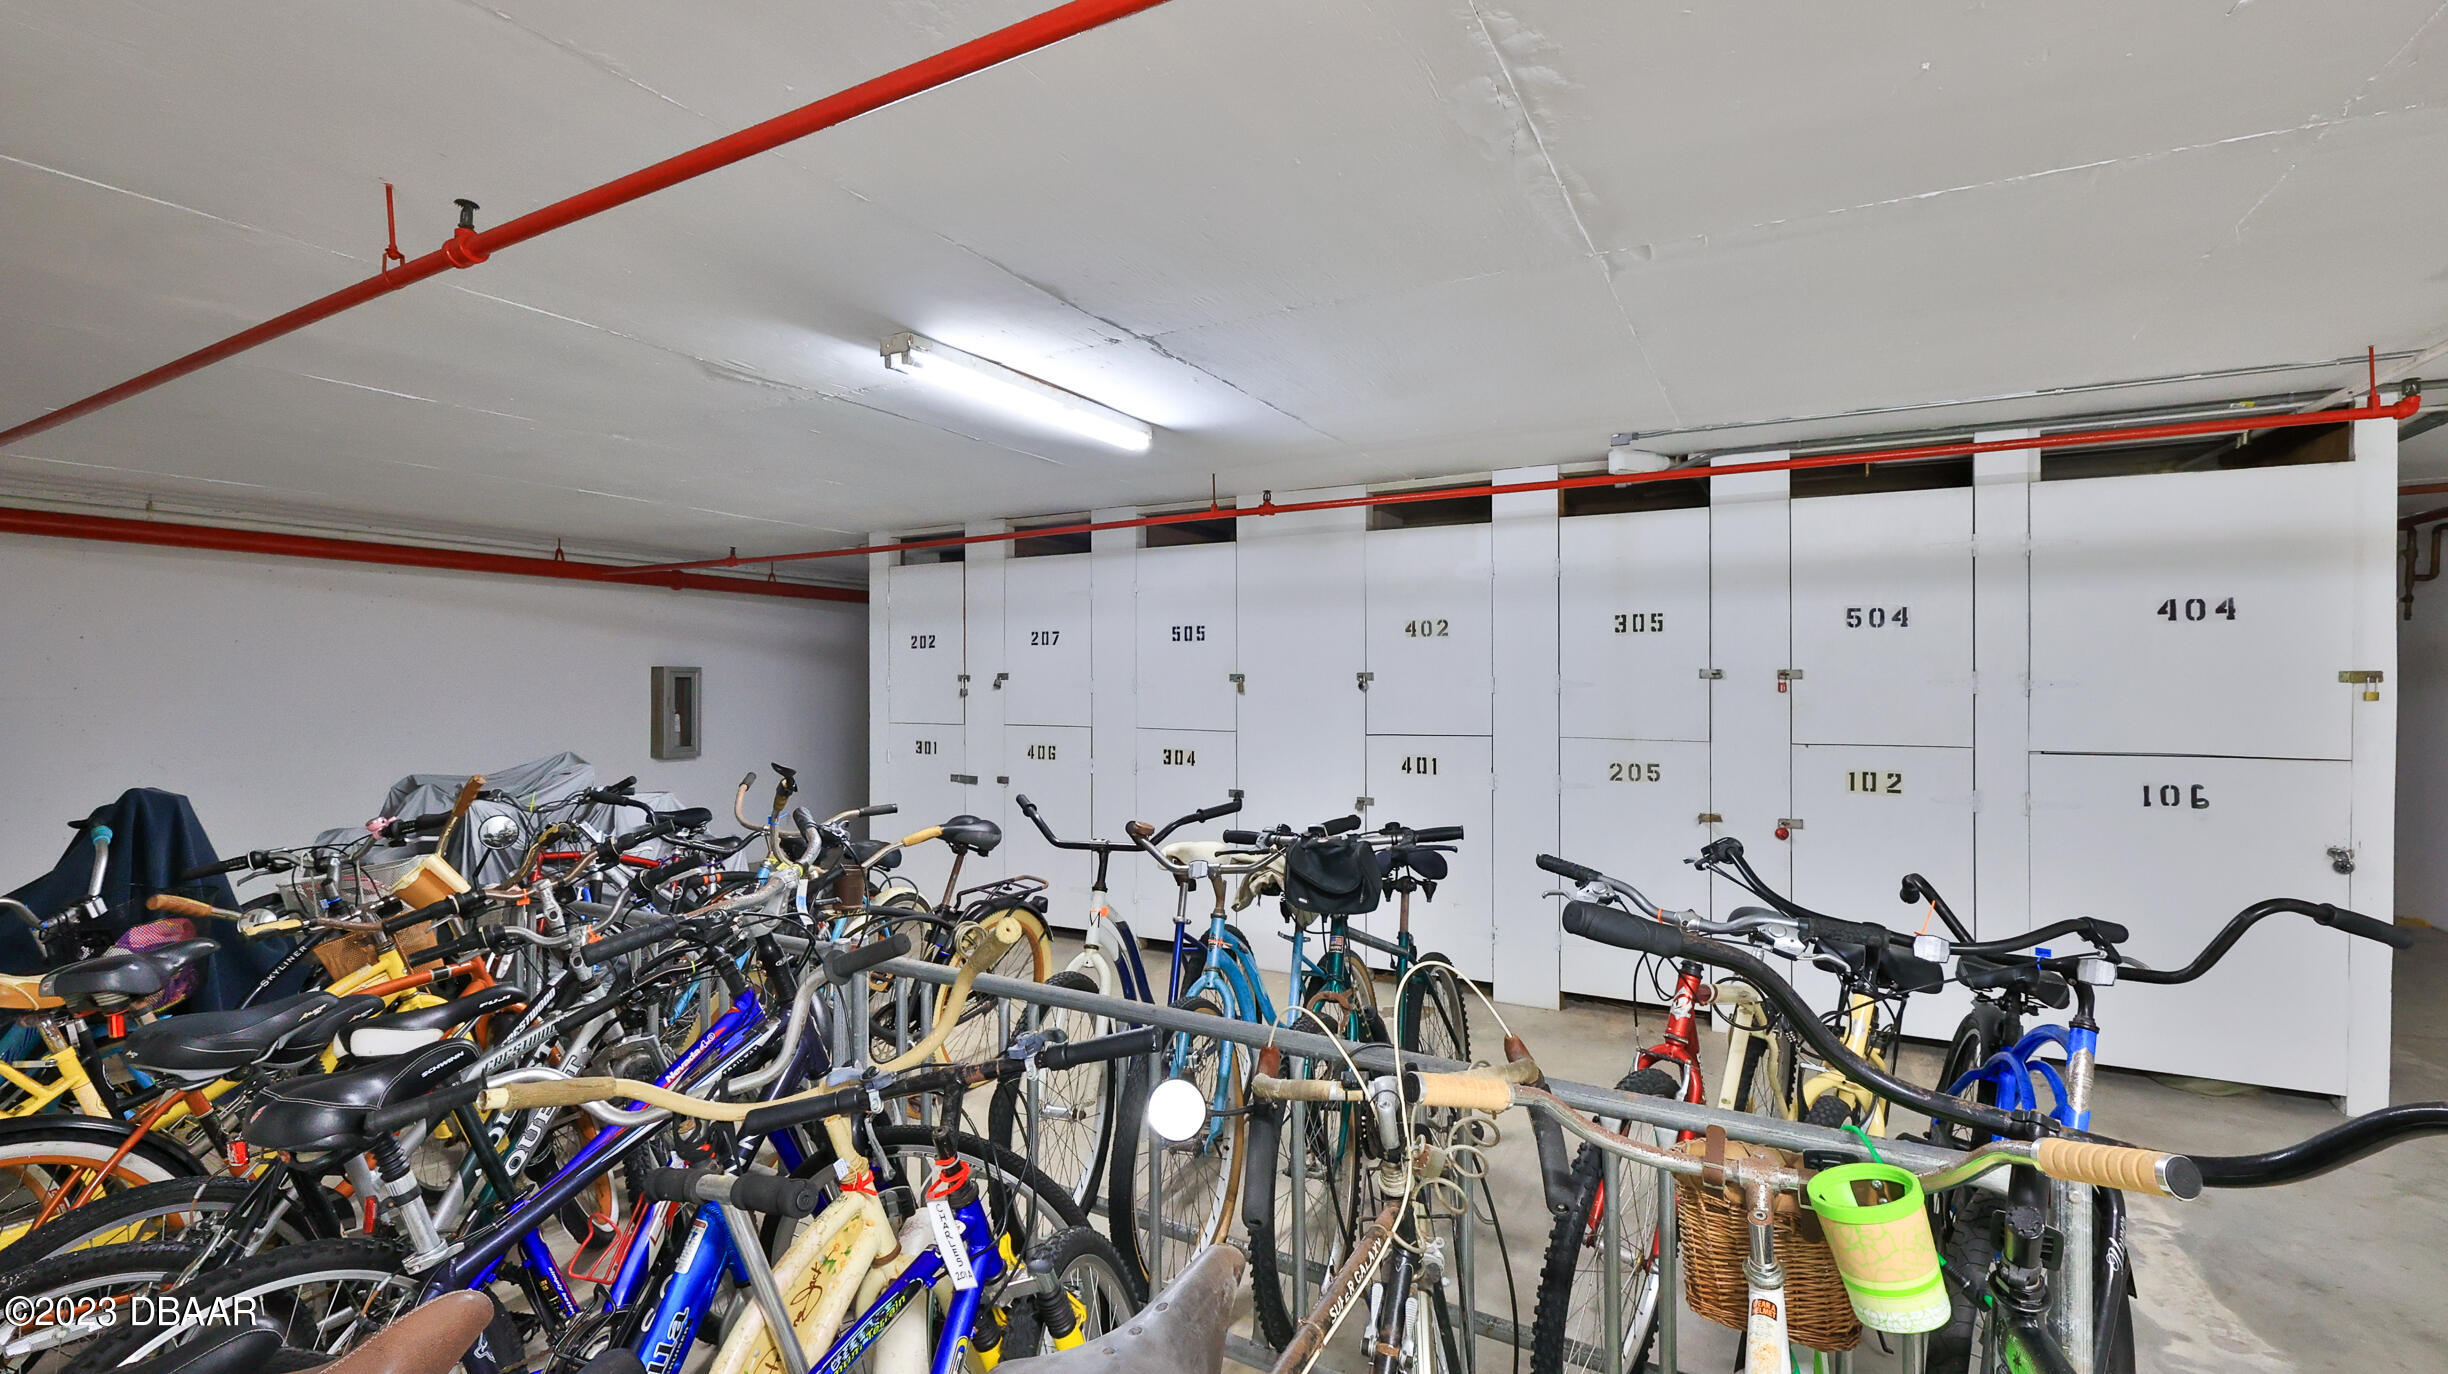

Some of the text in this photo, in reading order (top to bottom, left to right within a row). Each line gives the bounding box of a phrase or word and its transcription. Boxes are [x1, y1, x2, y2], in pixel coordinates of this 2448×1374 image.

[1846, 606, 1910, 629] 504
[2156, 597, 2237, 622] 404
[1404, 619, 1450, 638] 402
[1613, 612, 1665, 633] 305
[911, 634, 937, 649] 202
[1030, 631, 1060, 646] 207
[1172, 625, 1206, 642] 505
[915, 740, 938, 755] 301
[1027, 744, 1057, 761] 406
[1162, 748, 1197, 767] 304
[1401, 756, 1440, 776] 401
[1608, 763, 1662, 783] 205
[1847, 771, 1903, 795] 102
[2142, 784, 2211, 810] 106
[260, 945, 308, 987] SKYLINER
[421, 1050, 465, 1078] SCHWINN
[664, 1048, 701, 1083] Nevada
[504, 1054, 582, 1177] QUET
[1354, 1237, 1382, 1284] GALAXY
